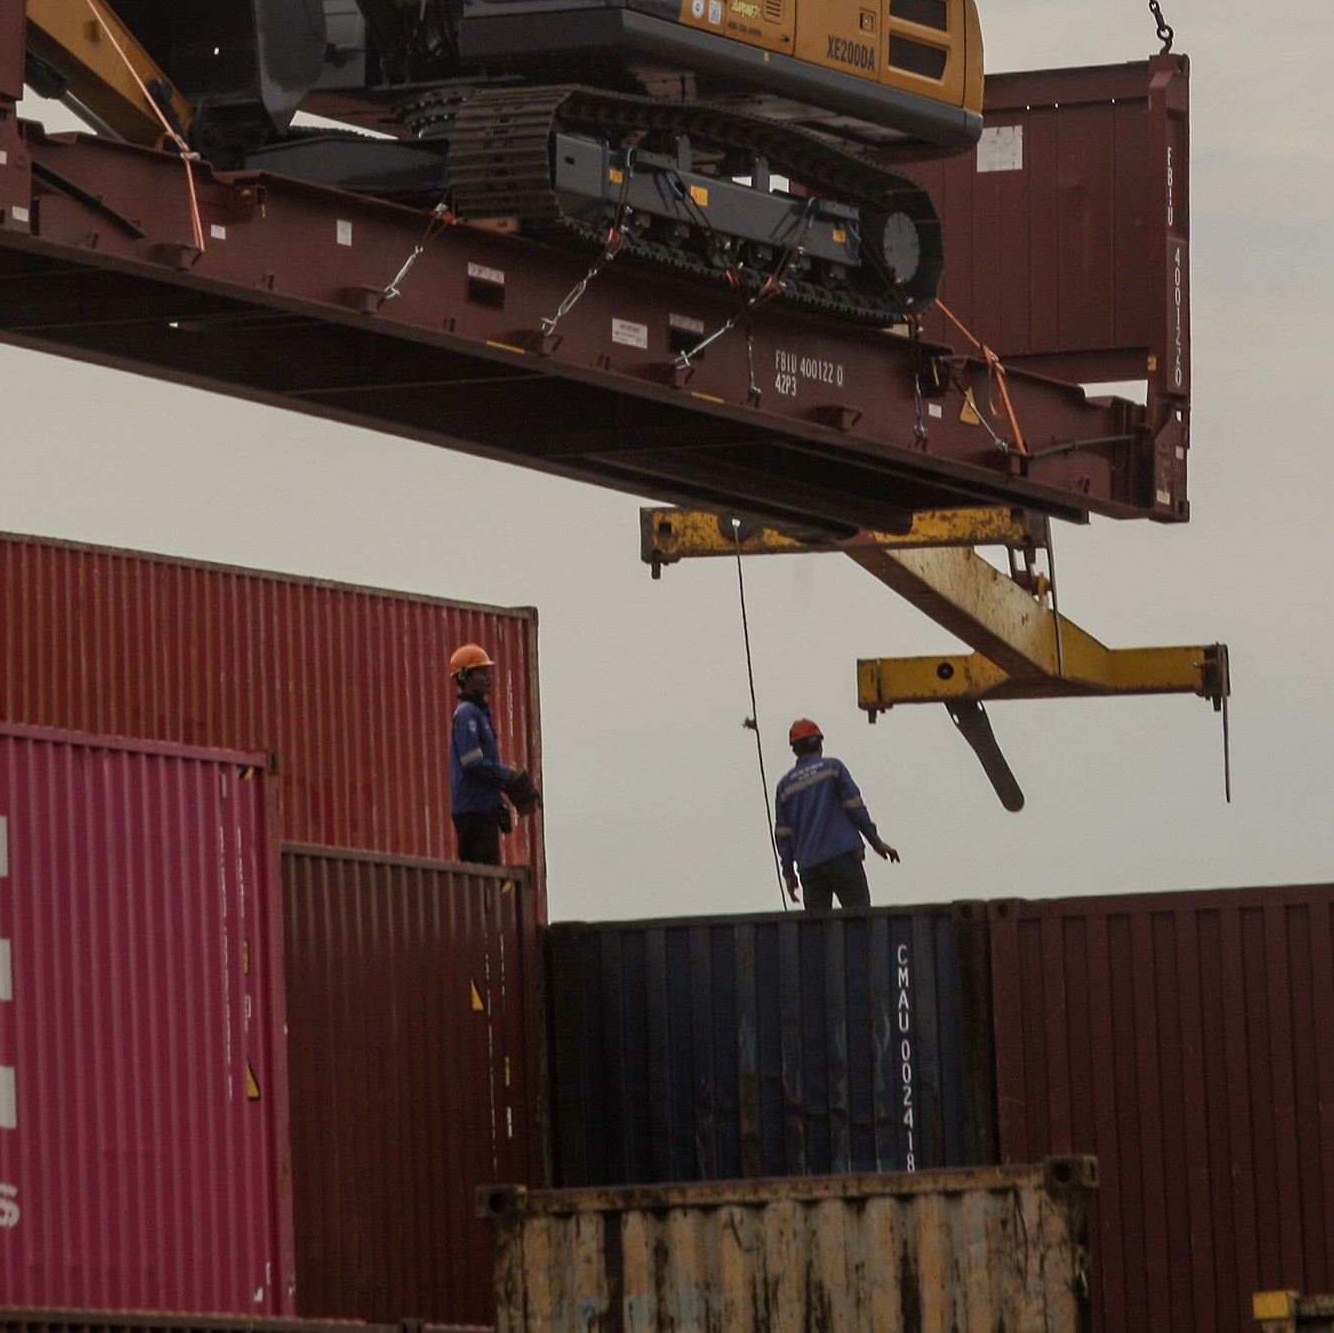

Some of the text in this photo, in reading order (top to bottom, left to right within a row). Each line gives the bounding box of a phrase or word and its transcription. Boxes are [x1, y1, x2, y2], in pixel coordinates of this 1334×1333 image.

[775, 350, 798, 373] FBIU
[800, 357, 834, 384] 400122
[775, 374, 797, 397] 42P3
[897, 944, 915, 1173] CMAU 002418
